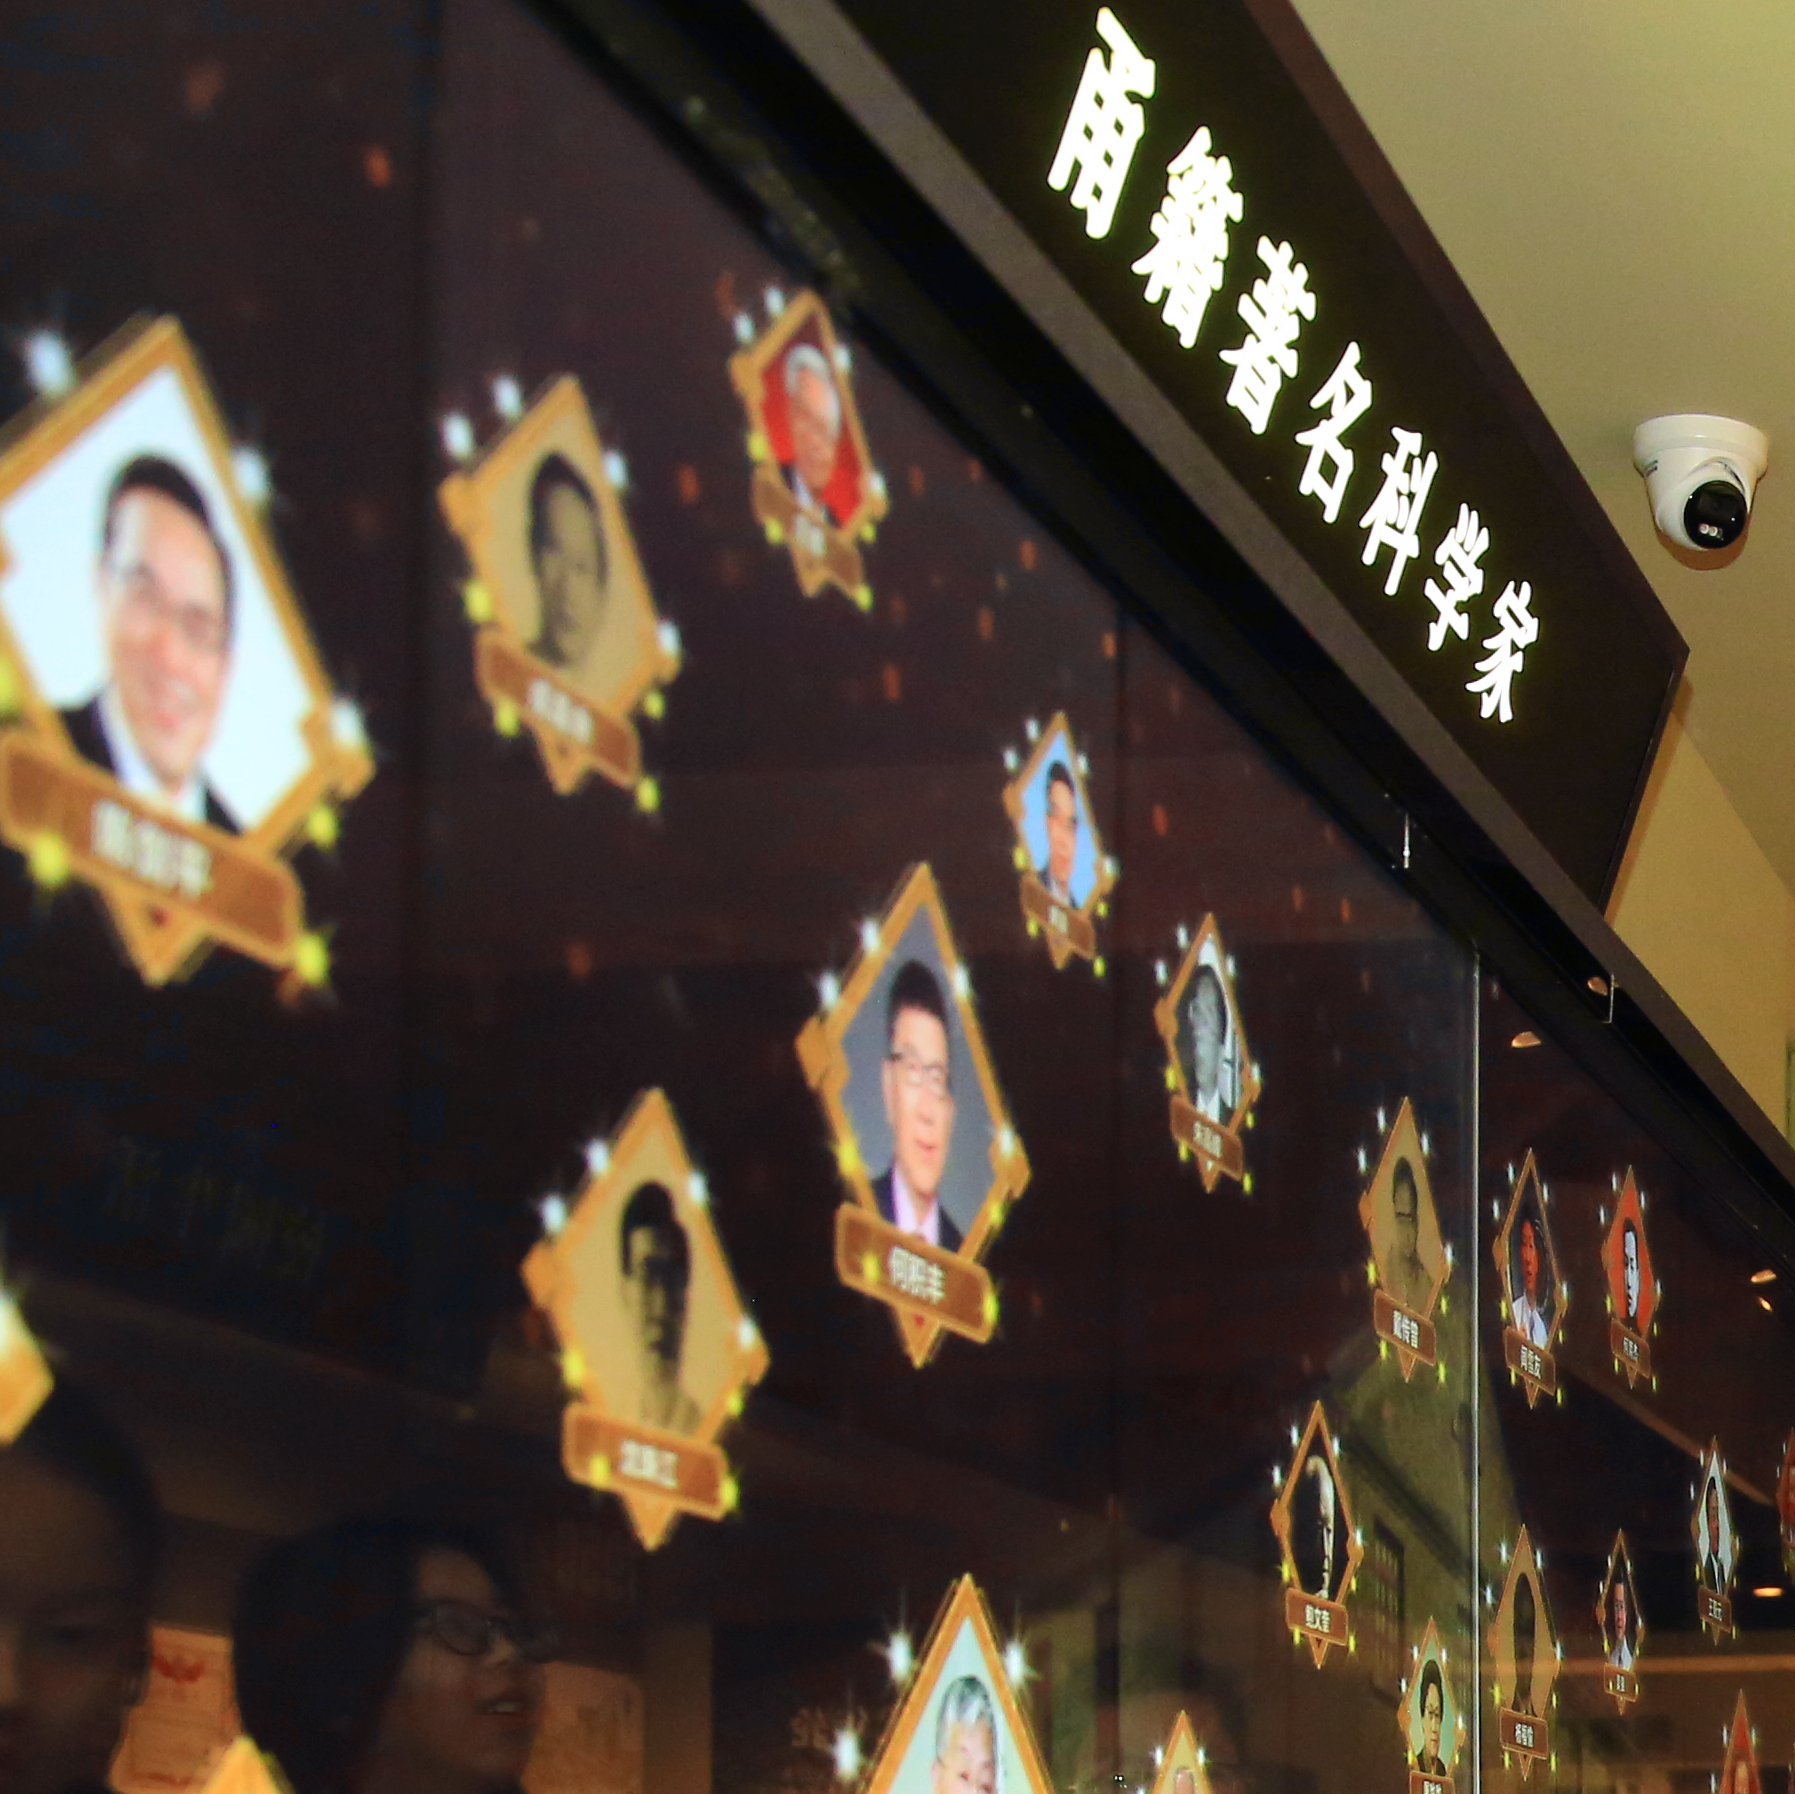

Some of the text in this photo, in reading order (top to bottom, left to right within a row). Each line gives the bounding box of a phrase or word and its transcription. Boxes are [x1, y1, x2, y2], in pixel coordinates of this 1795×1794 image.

[1047, 7, 1540, 722] 甬籍著名科学家
